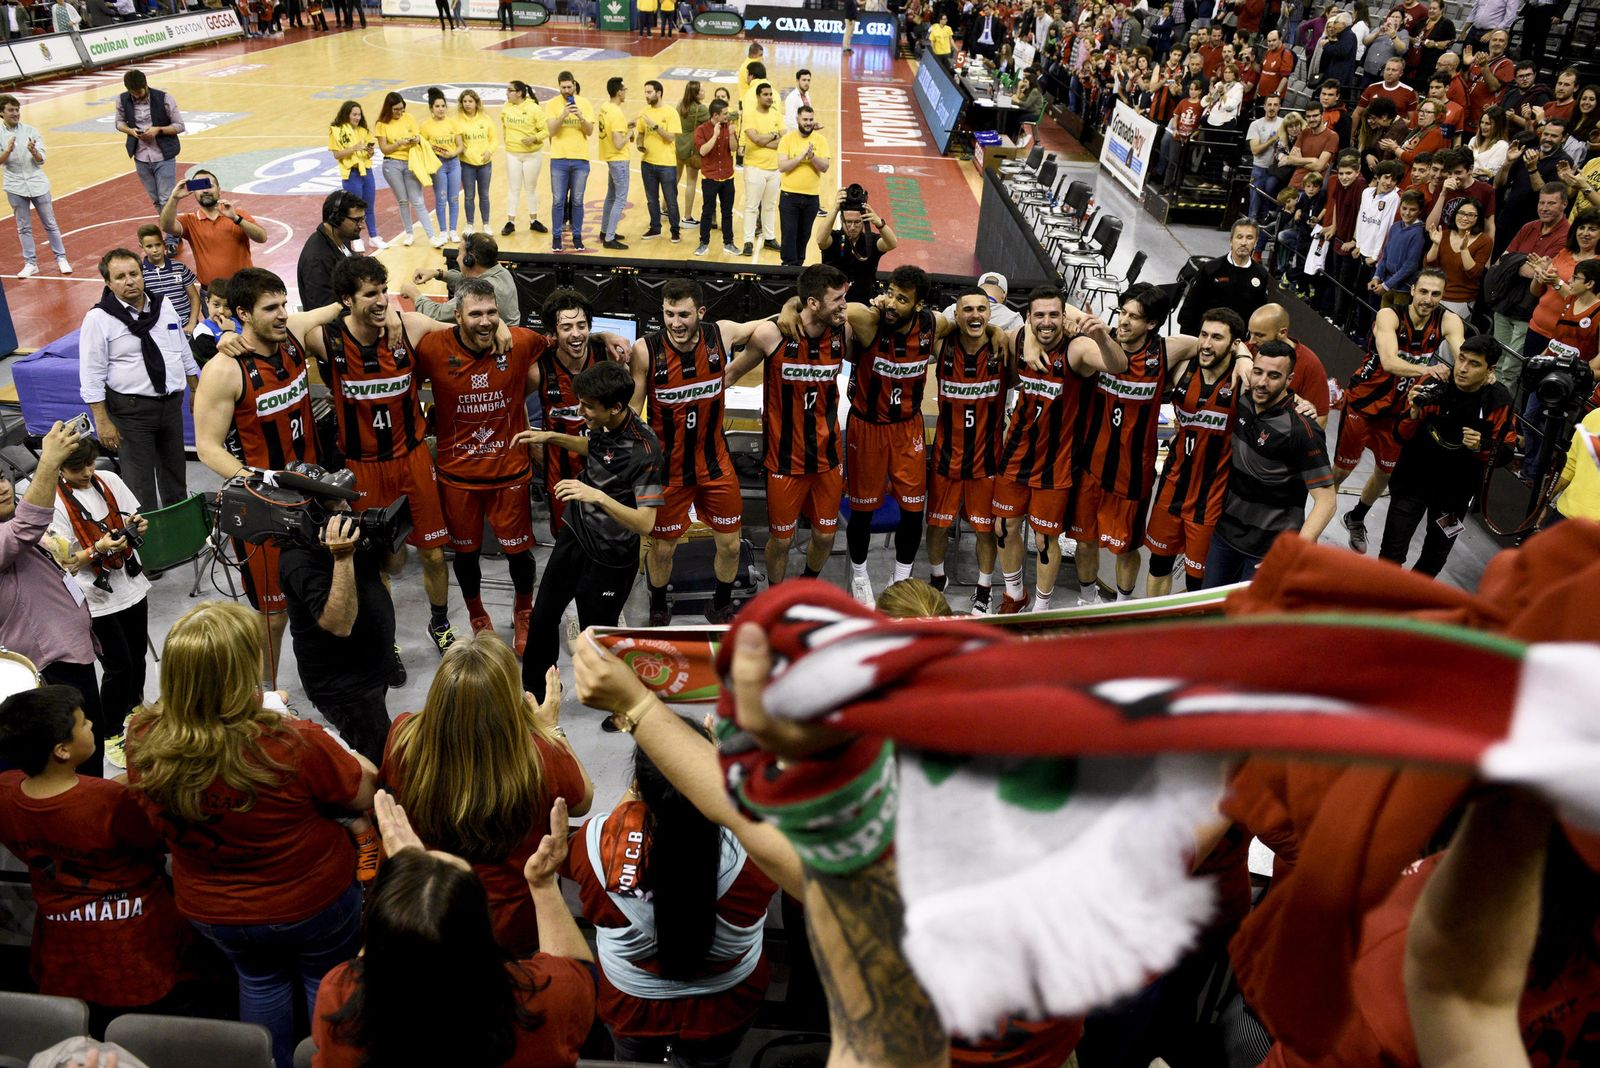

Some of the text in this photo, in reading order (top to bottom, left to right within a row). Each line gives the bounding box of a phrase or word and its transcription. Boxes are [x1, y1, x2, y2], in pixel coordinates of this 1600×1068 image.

[175, 23, 203, 35] DEKTON
[775, 17, 811, 32] CAJA
[814, 19, 863, 35] RURL
[90, 38, 129, 55] COVIRAN
[133, 31, 167, 47] COVIRAN
[857, 86, 927, 147] GRANADA
[458, 390, 503, 403] CERVEZAS
[657, 381, 721, 400] COVIRAN
[890, 387, 902, 405] 12
[943, 383, 999, 396] COVIRAN
[456, 400, 506, 413] ALHAMBRA
[804, 391, 818, 410] 17
[372, 410, 392, 430] 41
[686, 411, 697, 429] 9
[965, 410, 974, 427] 5
[1112, 408, 1122, 427] 3
[290, 416, 304, 440] 21
[234, 516, 242, 526] 3
[820, 518, 837, 526] asis
[625, 831, 643, 860] C.B
